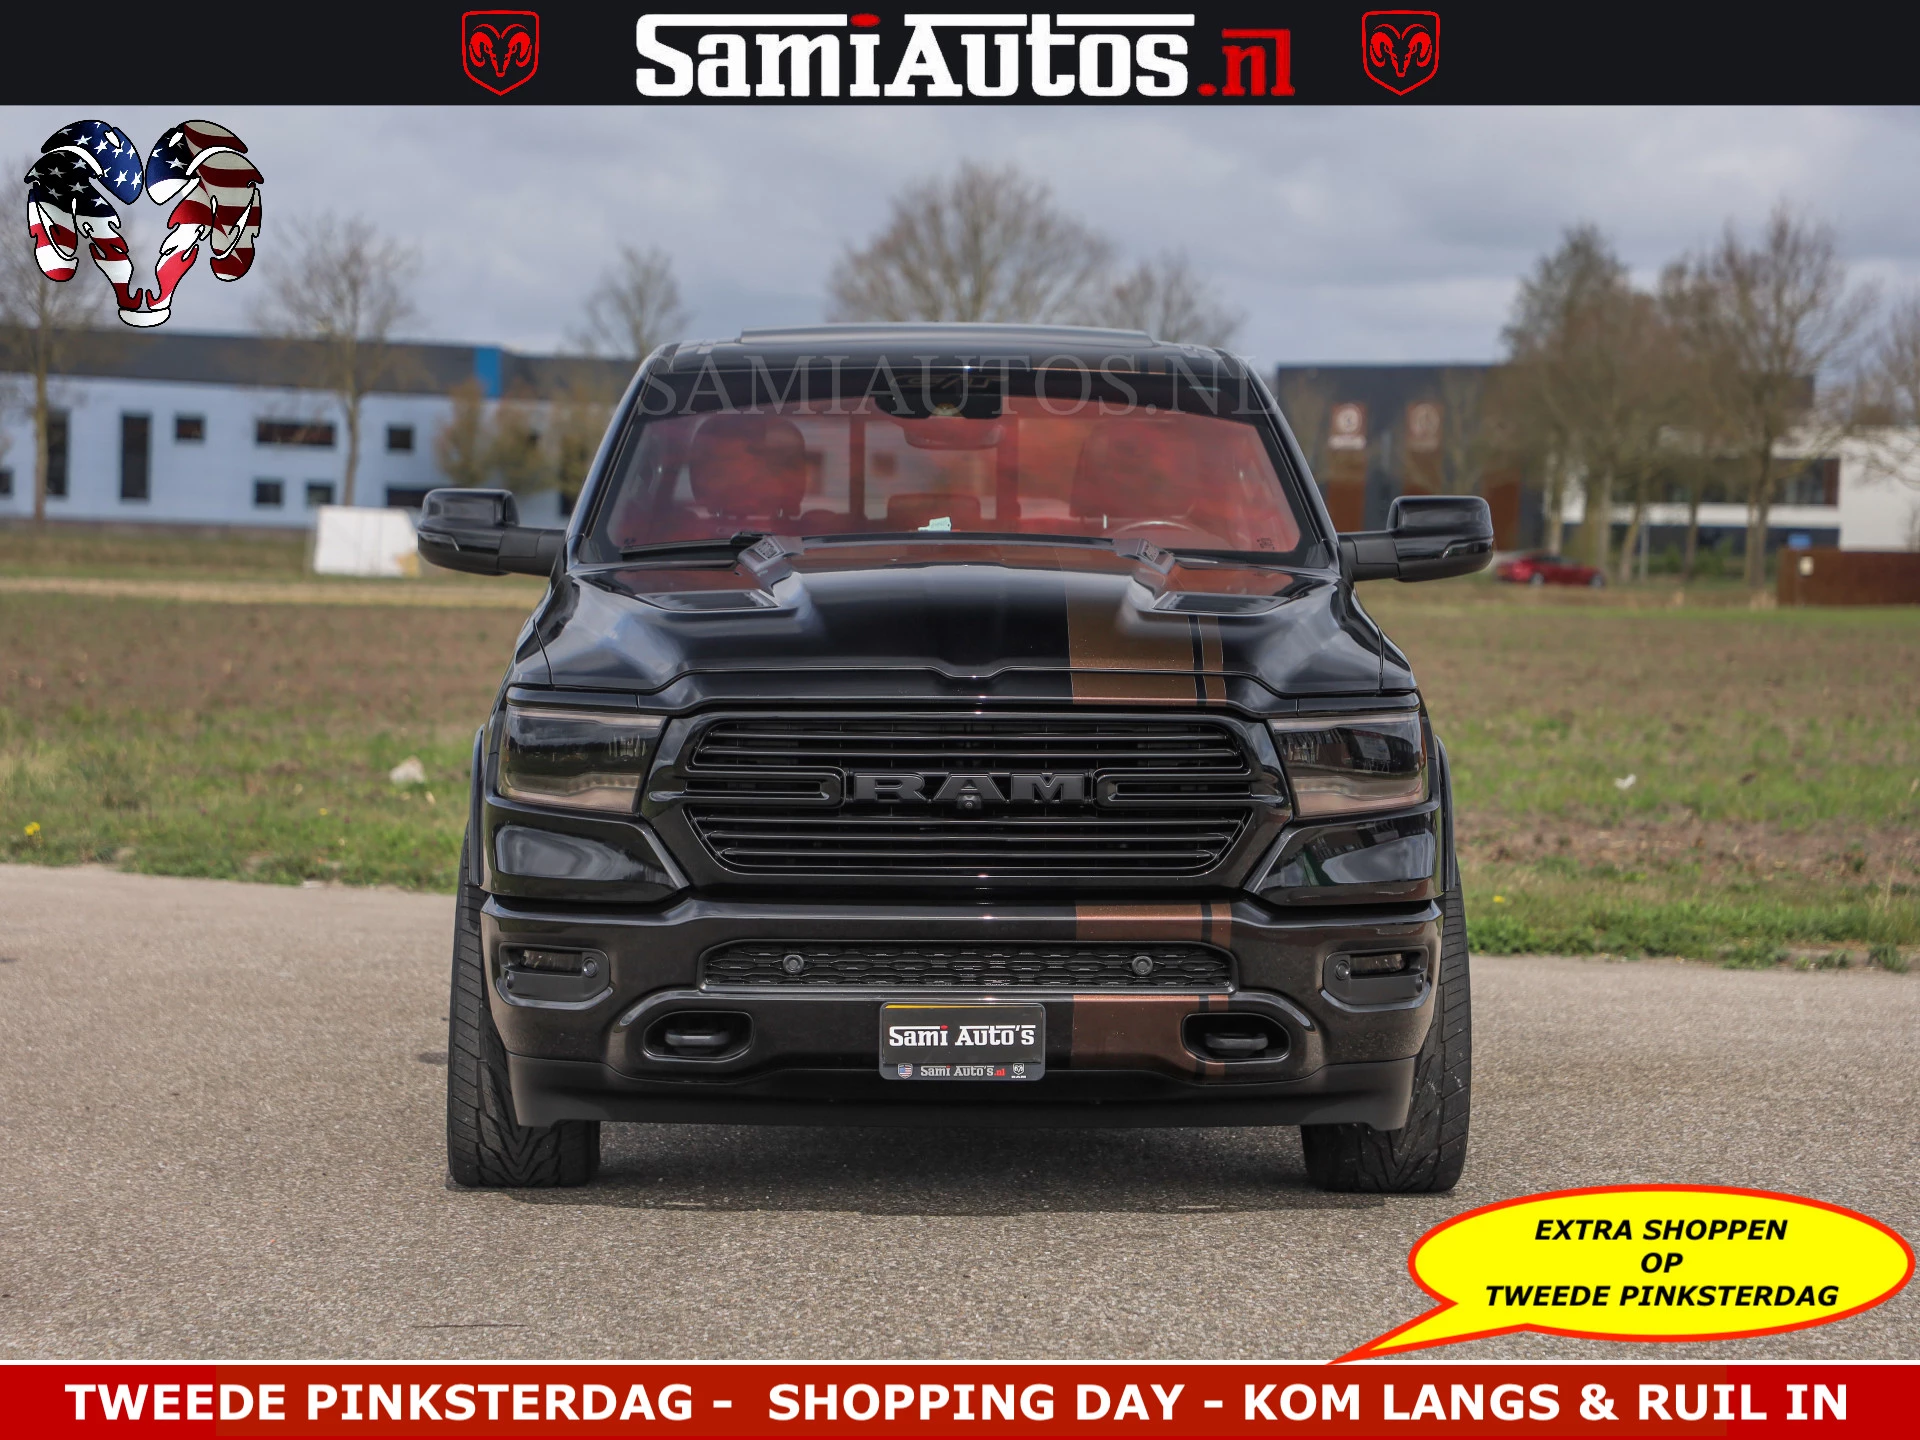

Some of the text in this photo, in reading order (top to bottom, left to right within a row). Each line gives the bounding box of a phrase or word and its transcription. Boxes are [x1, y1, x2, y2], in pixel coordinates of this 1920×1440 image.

[854, 773, 1086, 801] RAM
[889, 1025, 1036, 1046] Sami Auto's
[921, 1065, 951, 1077] Sami
